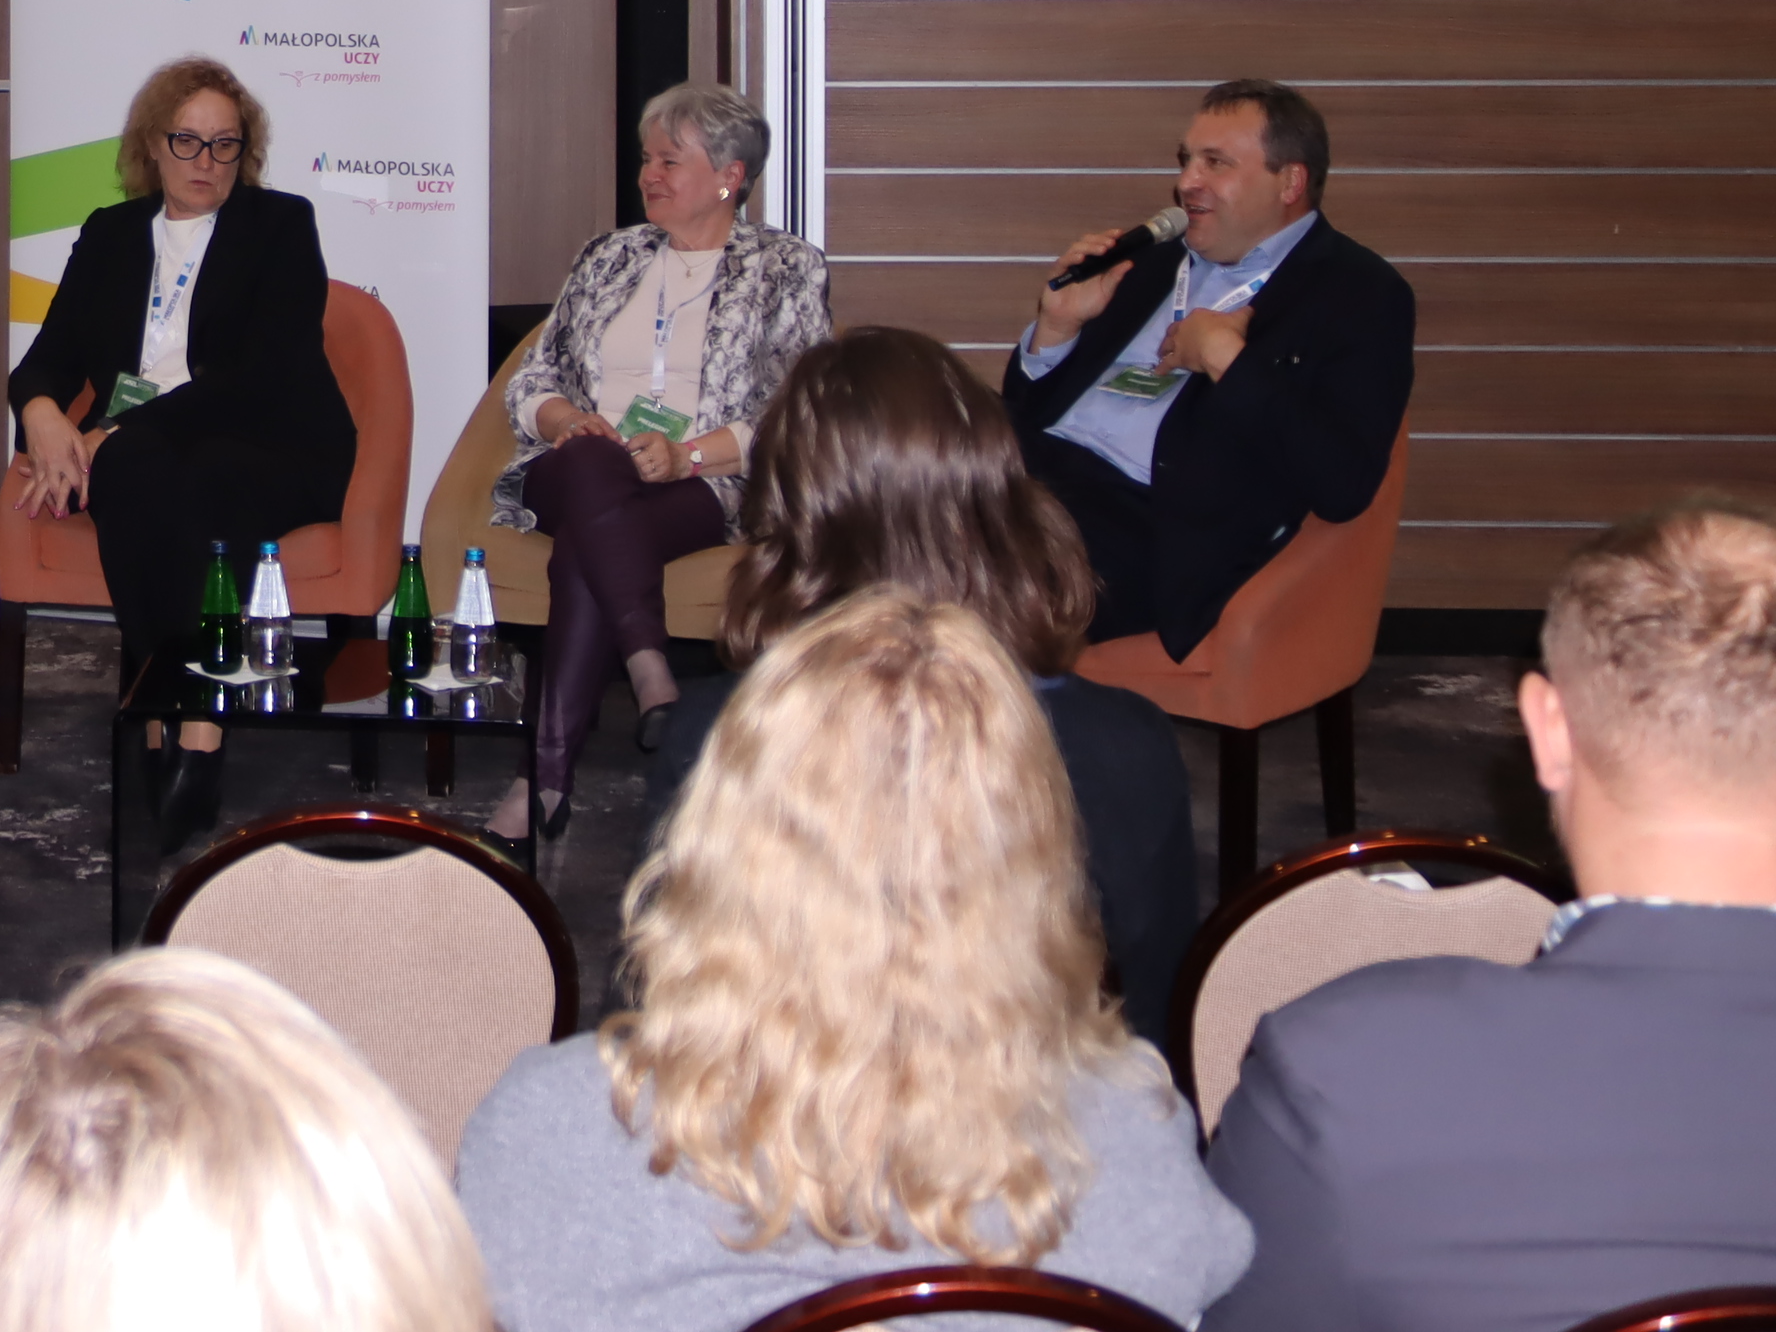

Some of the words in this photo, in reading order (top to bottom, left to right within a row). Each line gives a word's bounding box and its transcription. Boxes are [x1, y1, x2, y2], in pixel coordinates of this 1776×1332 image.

[264, 32, 380, 48] MAŁOPOLSKA
[344, 52, 380, 64] UCZY
[323, 71, 381, 85] pomysłem
[337, 159, 455, 177] MAŁOPOLSKA
[417, 180, 455, 193] UCZY
[396, 200, 456, 214] pomysłem
